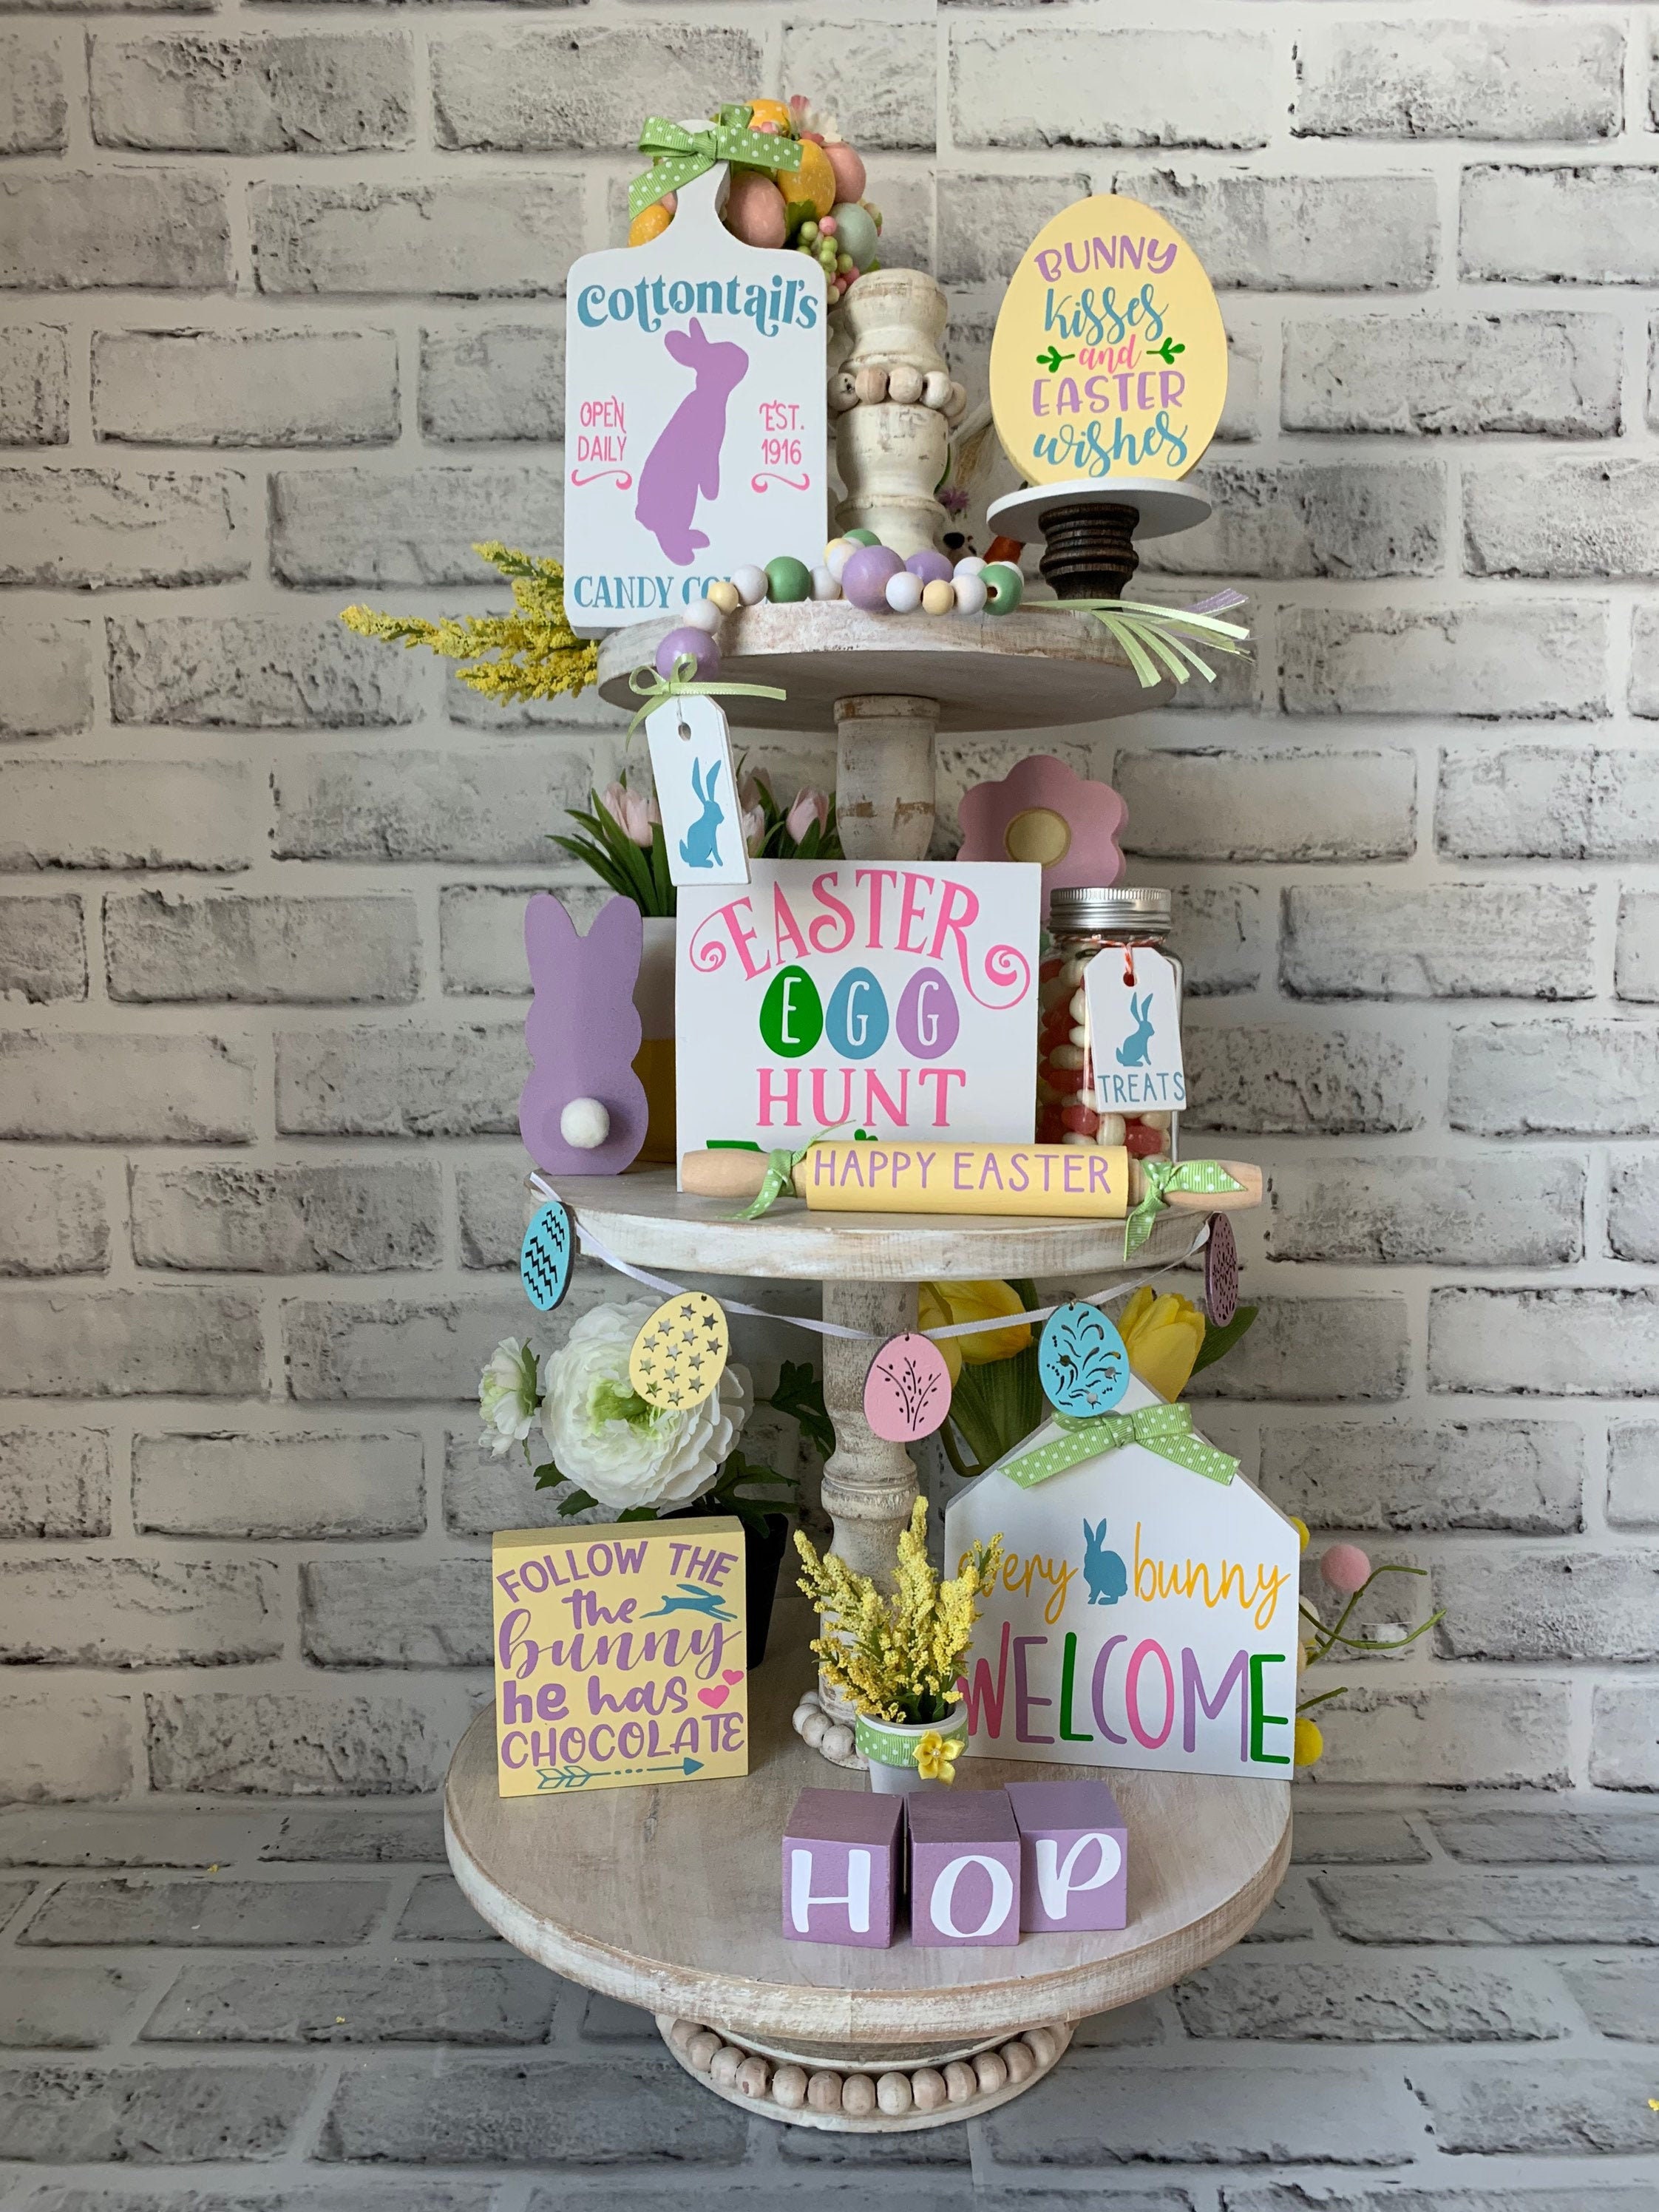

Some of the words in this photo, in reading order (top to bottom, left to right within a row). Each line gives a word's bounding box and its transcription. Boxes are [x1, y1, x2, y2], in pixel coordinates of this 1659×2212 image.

[1034, 235, 1178, 282] BUNNY
[577, 274, 819, 337] Cottontail's
[1044, 283, 1170, 346] kisses
[1079, 333, 1142, 374] and
[580, 395, 627, 433] OPEN
[759, 400, 804, 432] EST.
[1032, 370, 1186, 417] EASTER
[577, 435, 628, 462] DAILY
[761, 439, 802, 465] 1916
[1032, 410, 1189, 478] wishes
[574, 575, 674, 609] CANDY
[689, 869, 1031, 1010] EASTER
[781, 976, 940, 1046] EGG
[756, 1068, 966, 1127] HUNT
[1097, 1071, 1186, 1104] TREATS
[813, 1149, 937, 1188] HAPPY
[952, 1152, 1112, 1195] EASTER
[496, 1541, 648, 1603] FOLLOW
[668, 1542, 739, 1587] THE
[1133, 1521, 1292, 1631] bunny
[561, 1588, 637, 1629] the
[498, 1607, 742, 1680] bunny
[503, 1678, 569, 1725] he
[587, 1675, 689, 1716] has
[956, 1621, 1291, 1765] WELCOME
[501, 1711, 745, 1769] CHOCOLATE
